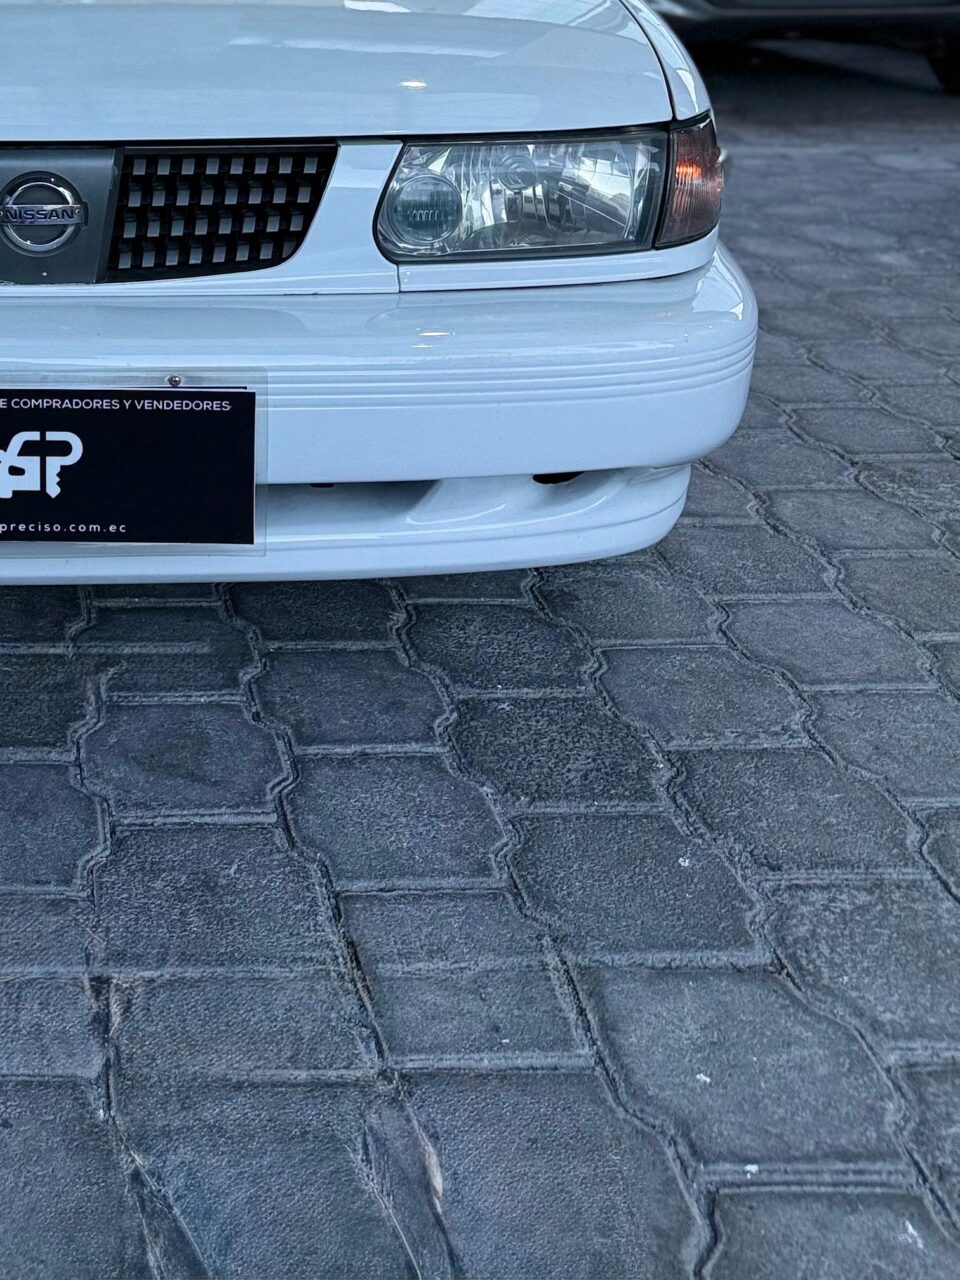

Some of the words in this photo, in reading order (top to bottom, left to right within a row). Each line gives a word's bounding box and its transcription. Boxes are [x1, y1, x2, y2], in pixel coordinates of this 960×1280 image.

[4, 208, 75, 221] NISSAN
[11, 398, 120, 410] COMPRADORES
[123, 399, 132, 410] Y
[134, 399, 231, 411] VENDEDORES
